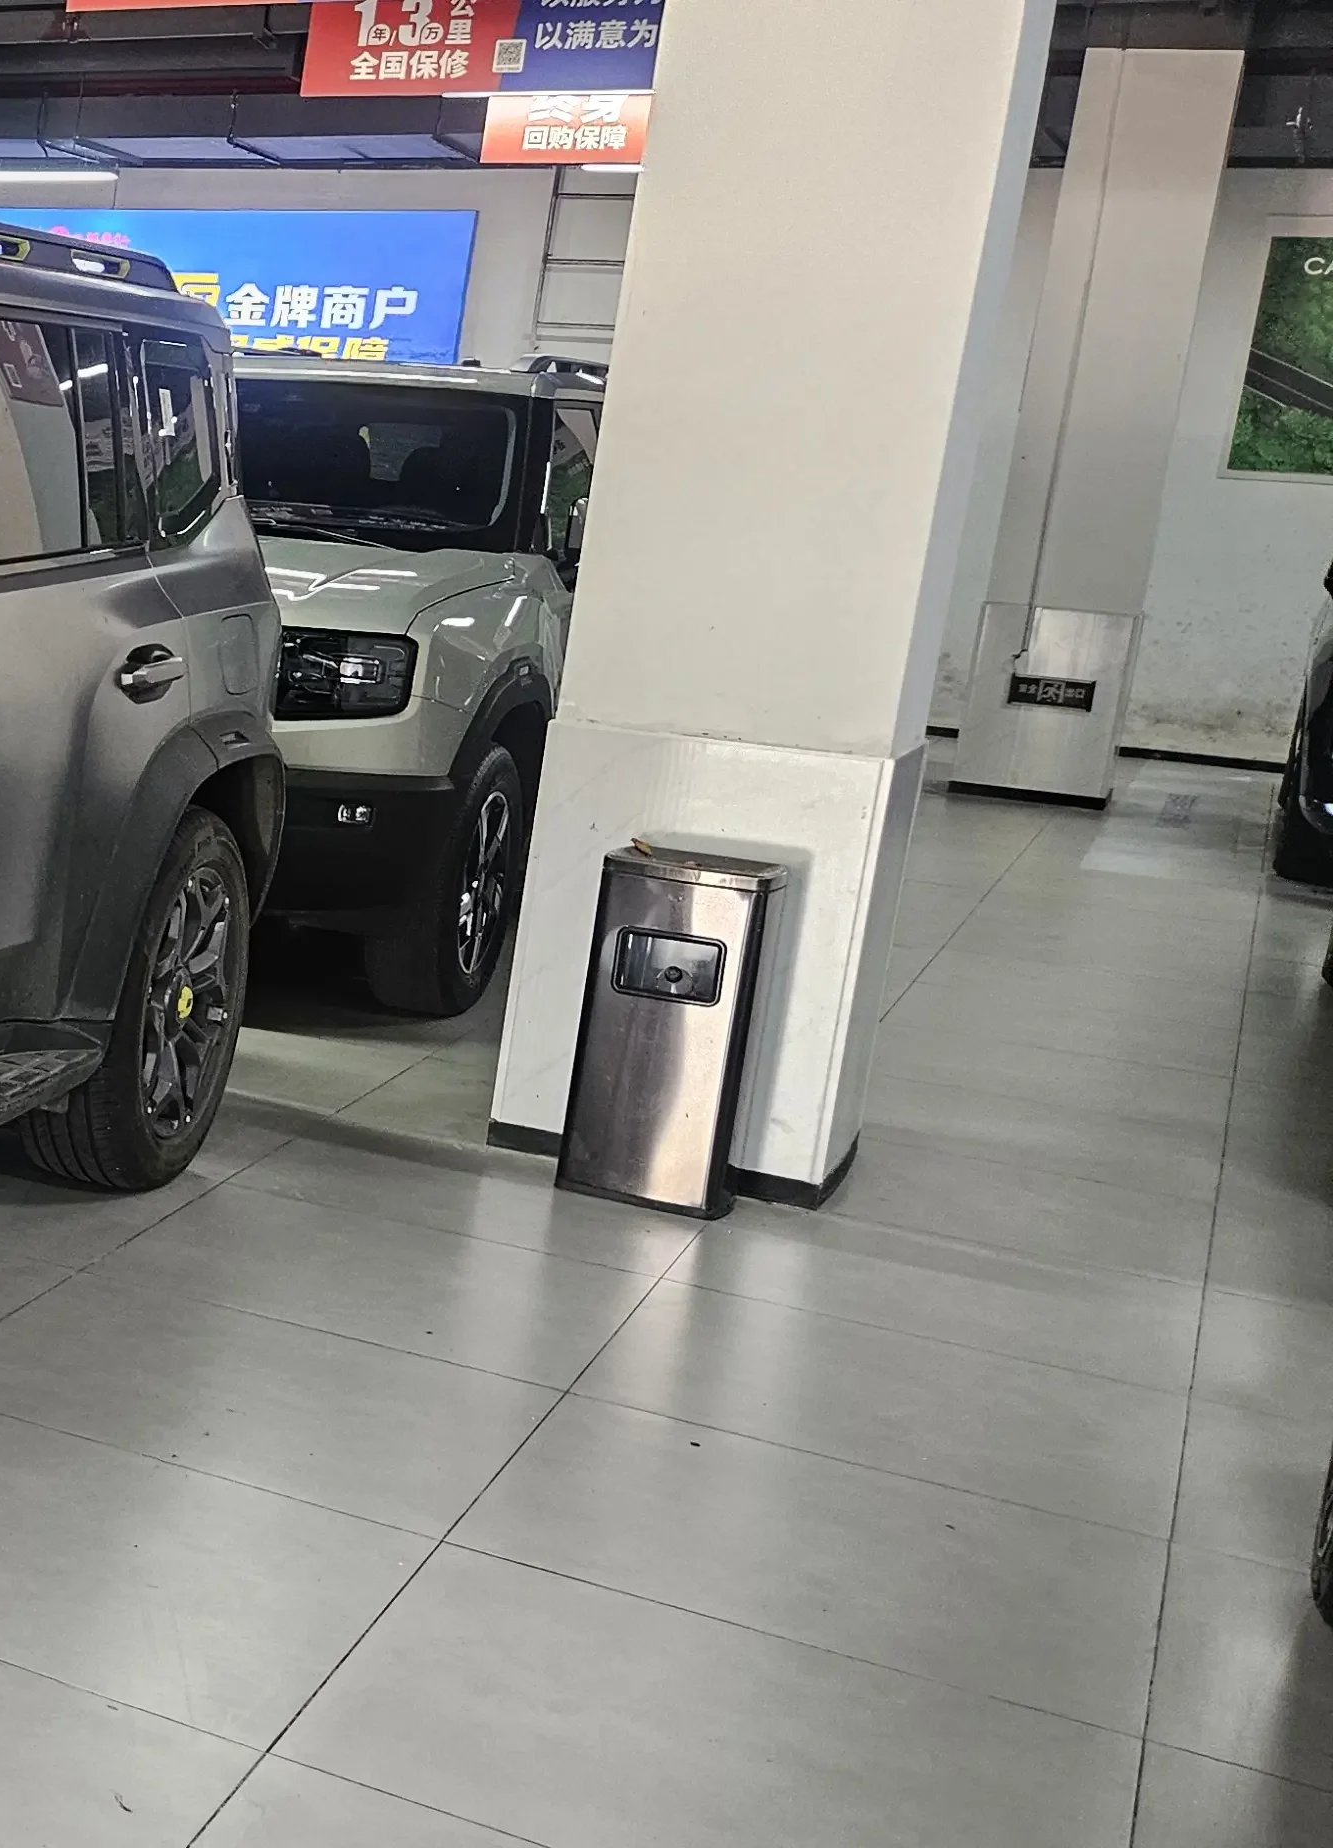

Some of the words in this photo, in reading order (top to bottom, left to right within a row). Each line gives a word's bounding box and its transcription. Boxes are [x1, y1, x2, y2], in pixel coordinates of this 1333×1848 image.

[534, 18, 660, 51] 以满意为
[348, 49, 471, 82] 全国保修
[521, 126, 630, 151] 回购保障
[223, 281, 419, 331] 金牌商户
